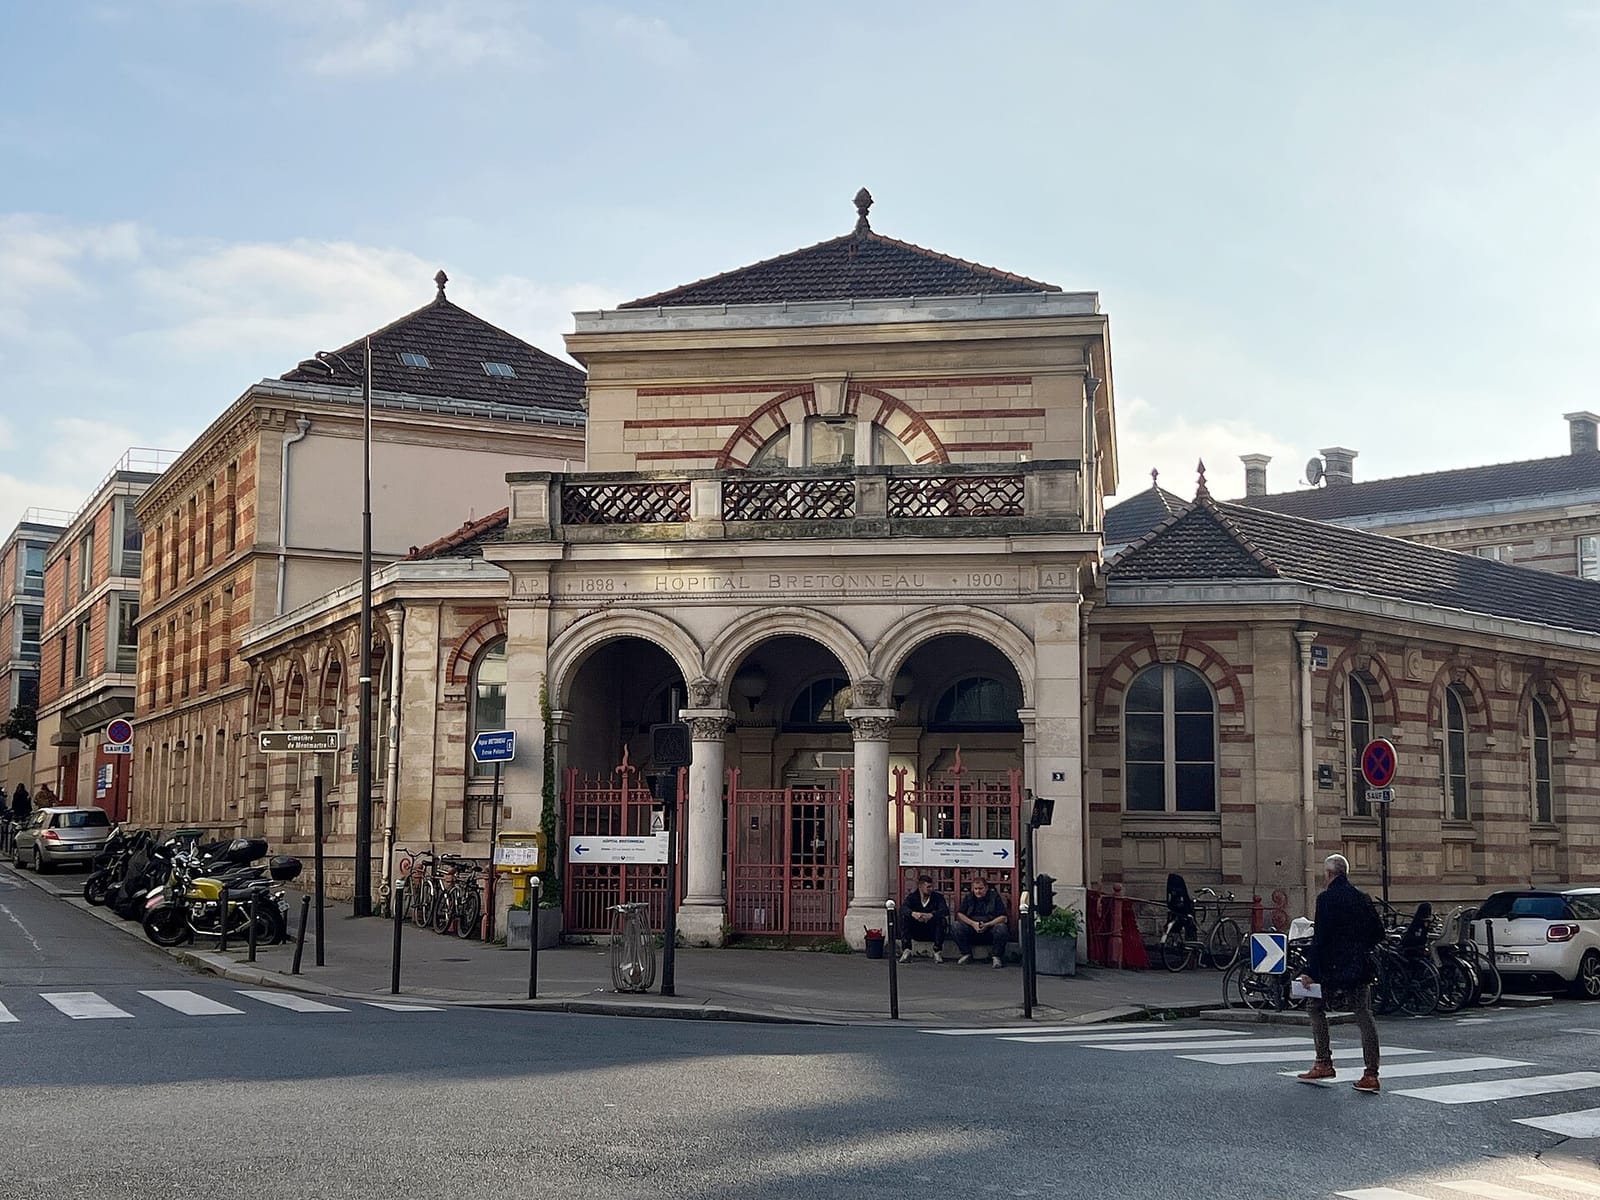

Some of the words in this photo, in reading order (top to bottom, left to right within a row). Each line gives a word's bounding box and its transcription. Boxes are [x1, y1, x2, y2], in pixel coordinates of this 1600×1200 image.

[580, 578, 614, 592] 1898
[655, 576, 751, 591] HOPITAL
[768, 573, 925, 589] BRETONNEAU
[966, 573, 1004, 587] 1900
[286, 734, 314, 743] Cimetière
[287, 742, 295, 750] de
[1367, 792, 1383, 800] SAUF
